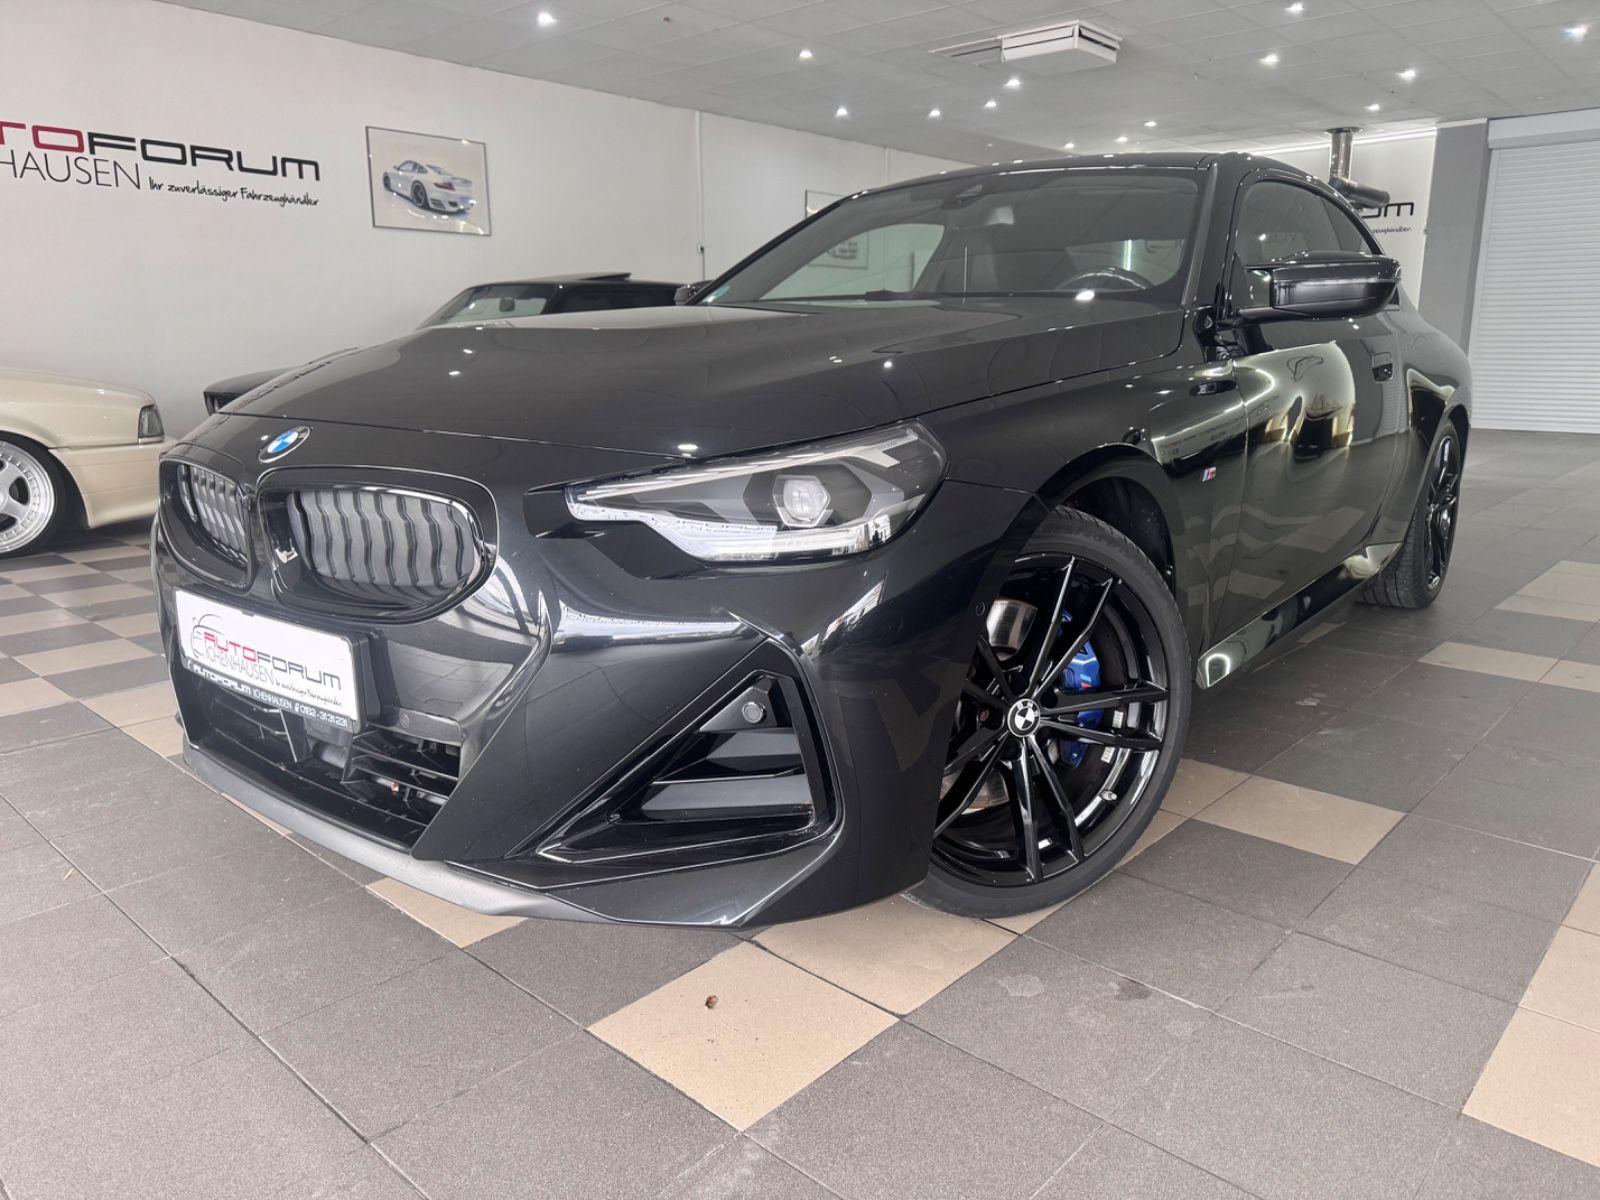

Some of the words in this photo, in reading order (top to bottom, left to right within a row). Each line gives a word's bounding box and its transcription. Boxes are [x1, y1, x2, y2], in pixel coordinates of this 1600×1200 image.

[149, 177, 164, 191] Ihr
[168, 180, 239, 201] zuverlässiger
[204, 632, 342, 690] AUTOFORUM
